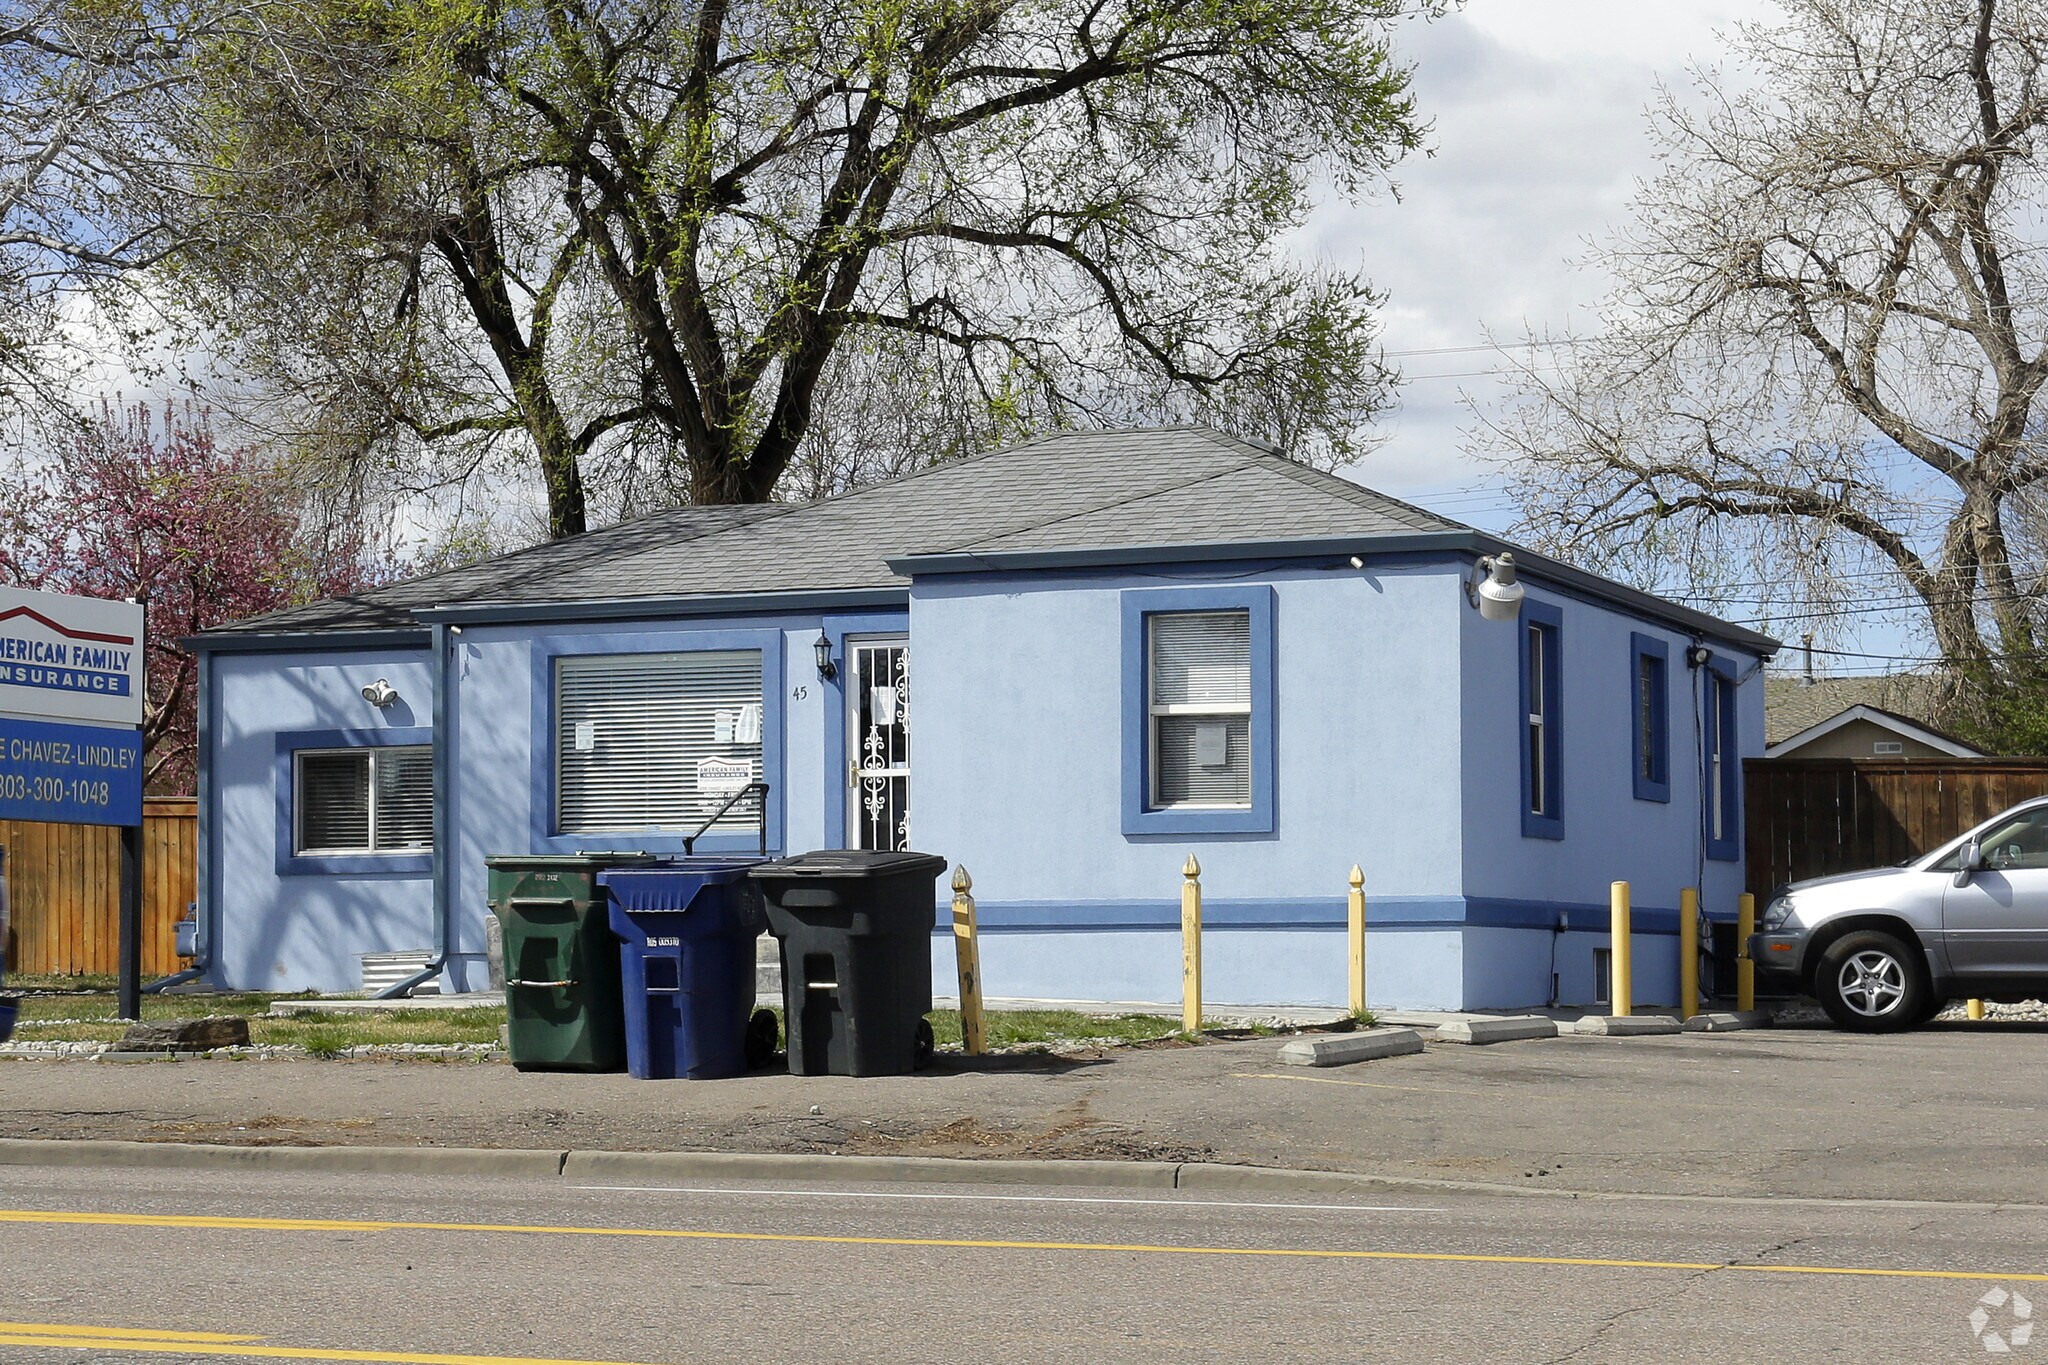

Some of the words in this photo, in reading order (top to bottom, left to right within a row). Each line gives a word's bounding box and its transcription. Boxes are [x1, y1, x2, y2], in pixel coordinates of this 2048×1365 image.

[73, 645, 131, 671] FAMILY
[0, 665, 119, 691] NSURANCE
[792, 685, 808, 701] 45
[10, 738, 137, 769] CHAVEZ-LINDLEY
